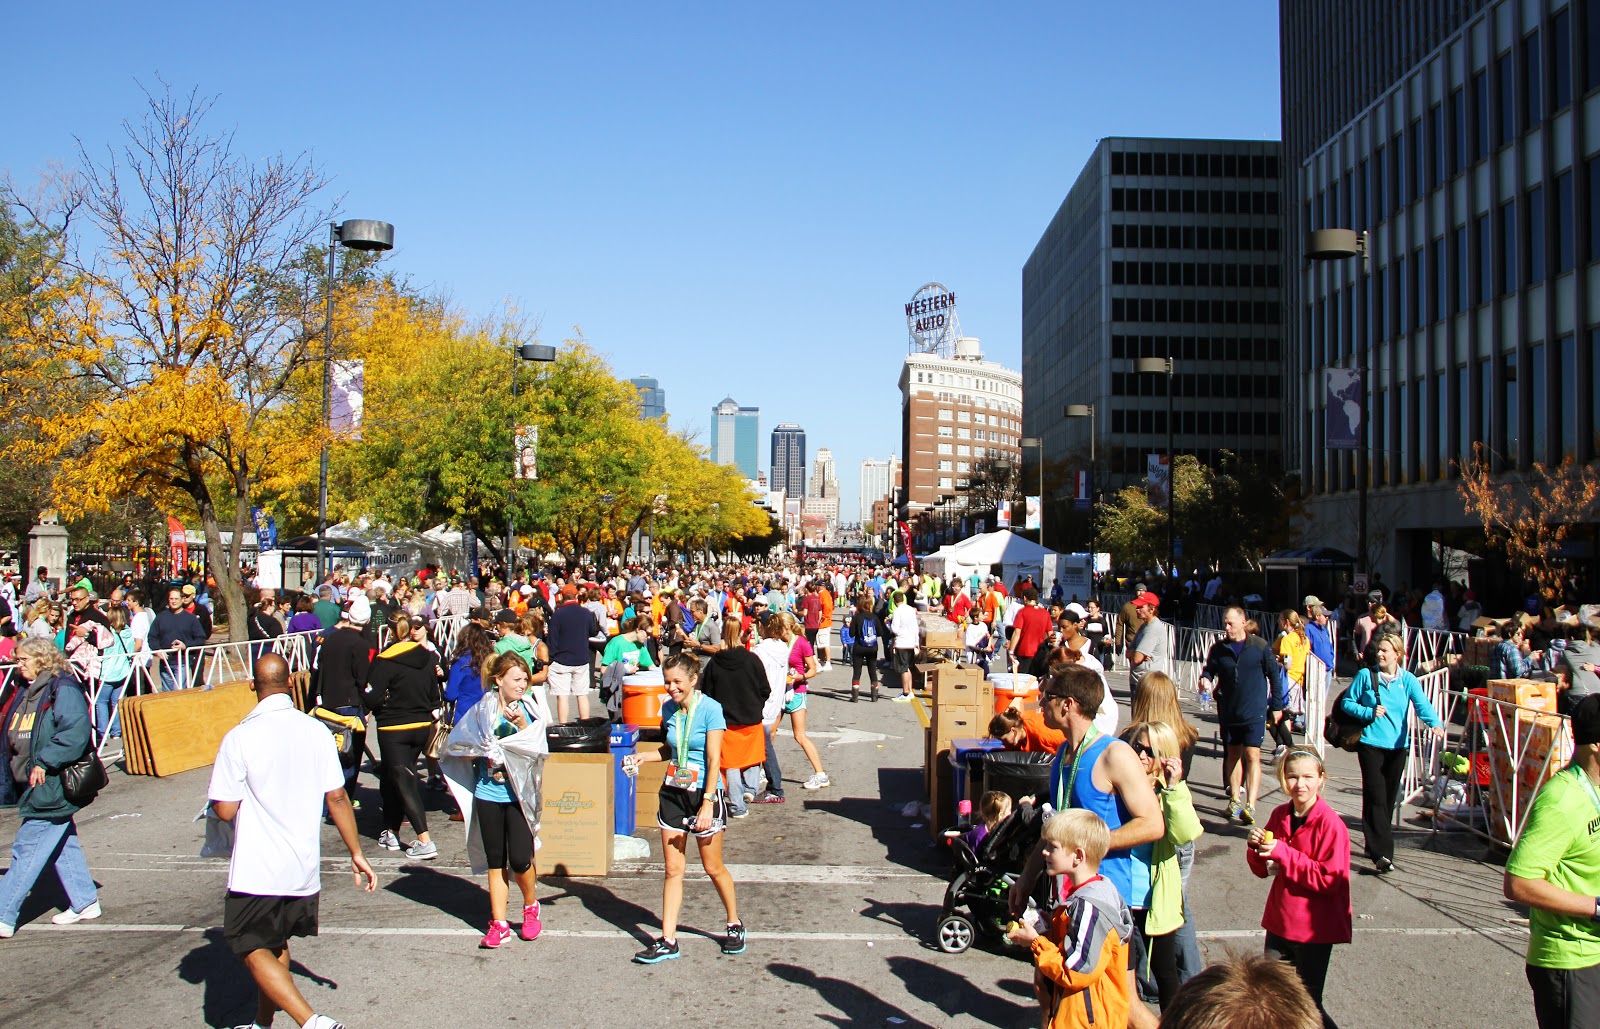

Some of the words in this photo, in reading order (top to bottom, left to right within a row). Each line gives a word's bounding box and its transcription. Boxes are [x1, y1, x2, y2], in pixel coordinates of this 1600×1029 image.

[905, 291, 955, 316] WESTERN
[916, 314, 945, 332] AUTO
[350, 552, 408, 566] Inrmation
